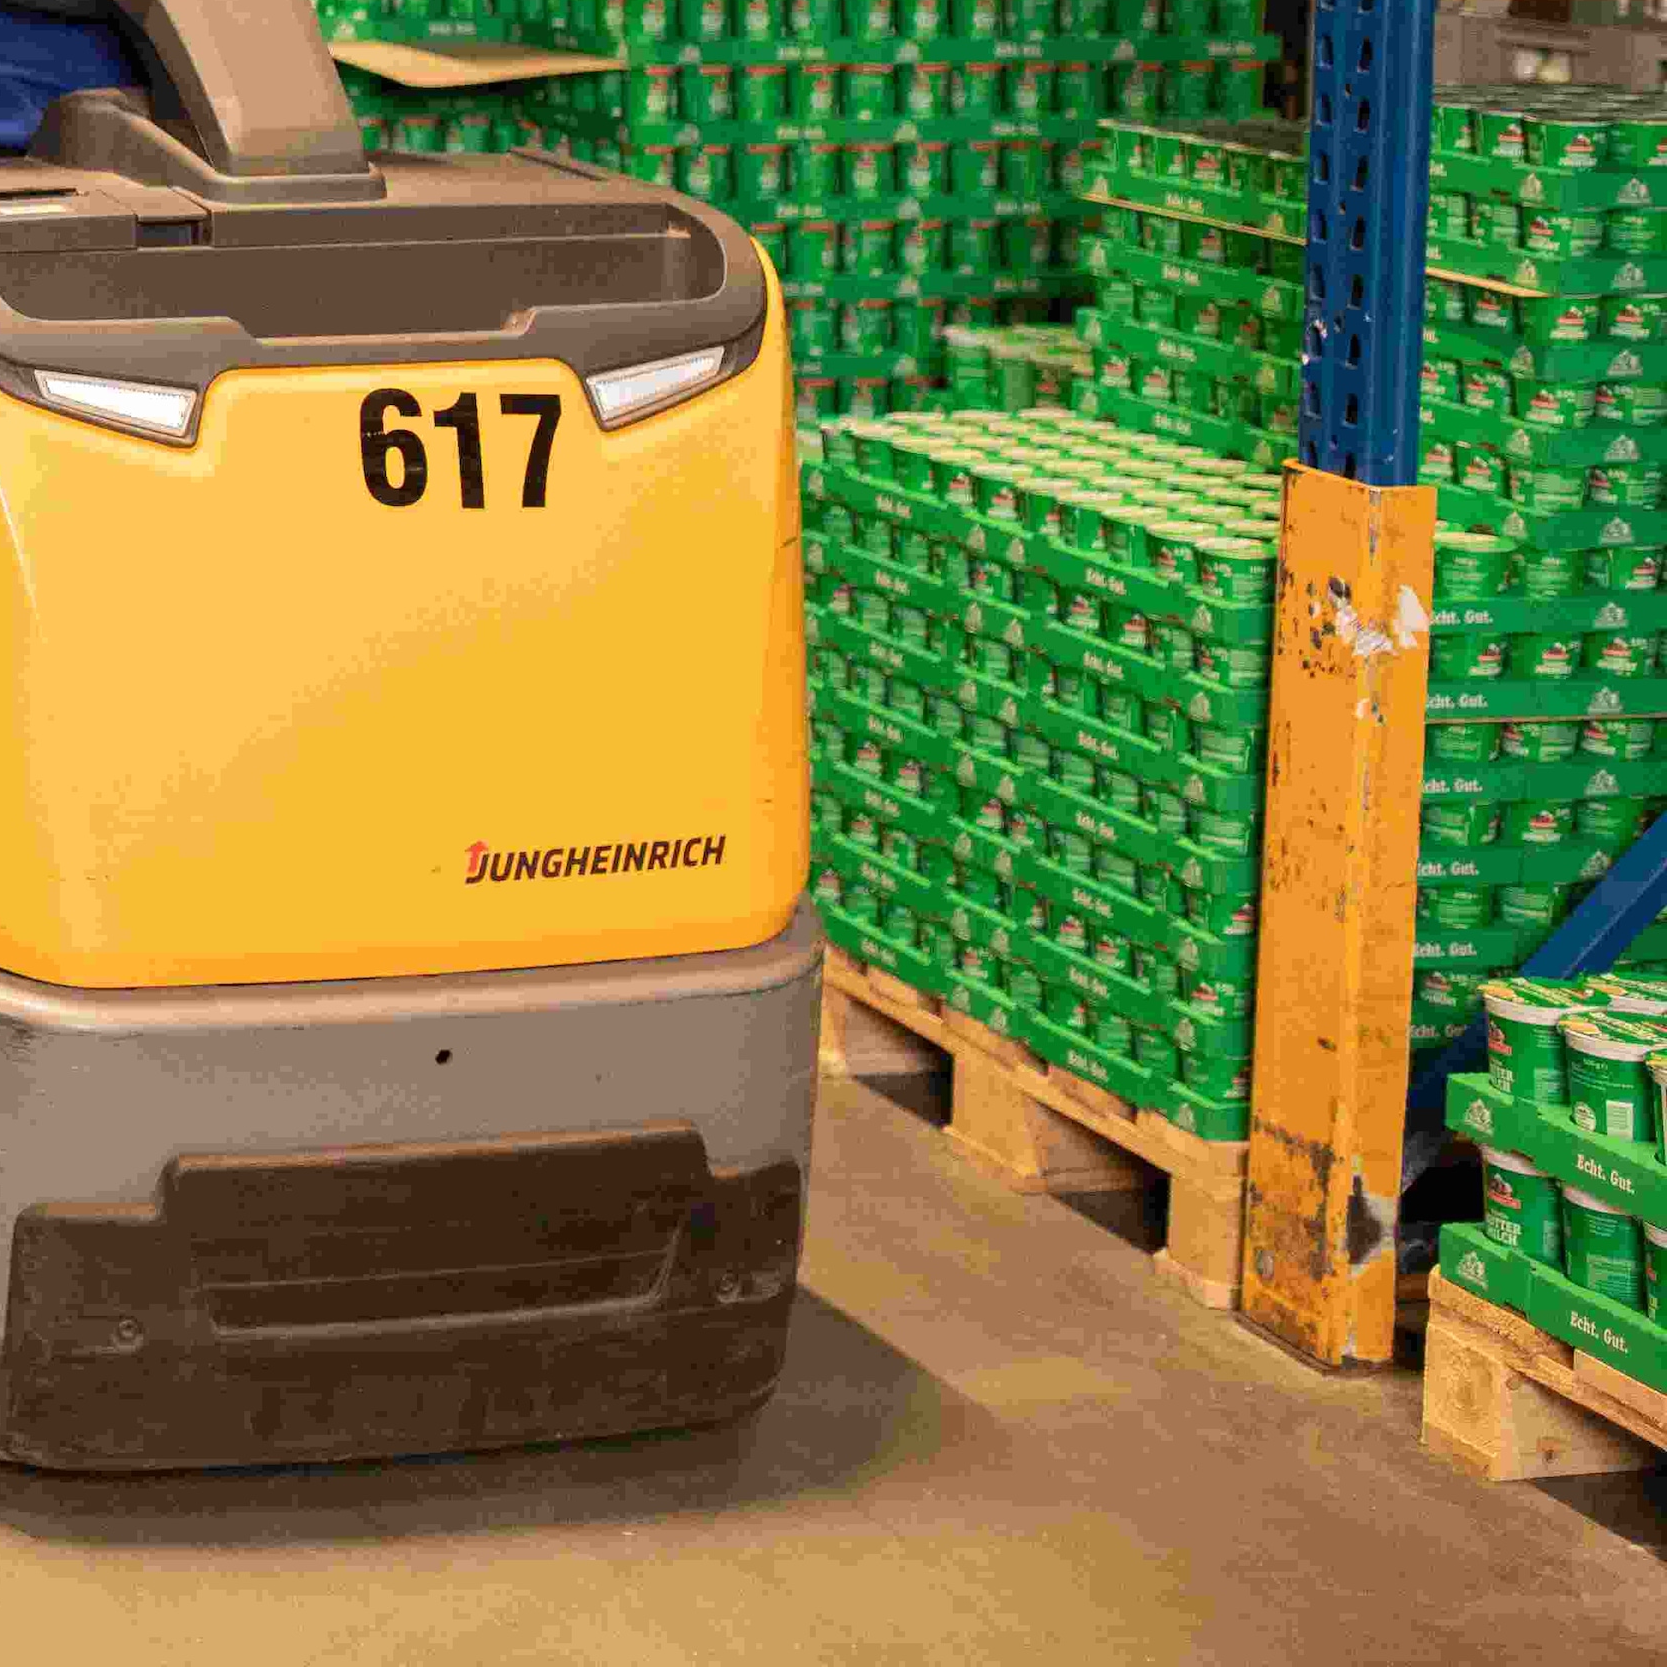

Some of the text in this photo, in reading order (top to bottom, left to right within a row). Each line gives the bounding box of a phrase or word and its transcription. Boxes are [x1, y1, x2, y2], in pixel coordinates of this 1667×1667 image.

[361, 389, 561, 508] 617
[1422, 779, 1451, 794] cht.
[466, 836, 726, 884] JUNGHEINRICH
[1576, 1154, 1636, 1195] Echt. Gut.
[1571, 1311, 1629, 1354] Echt. Gut.
